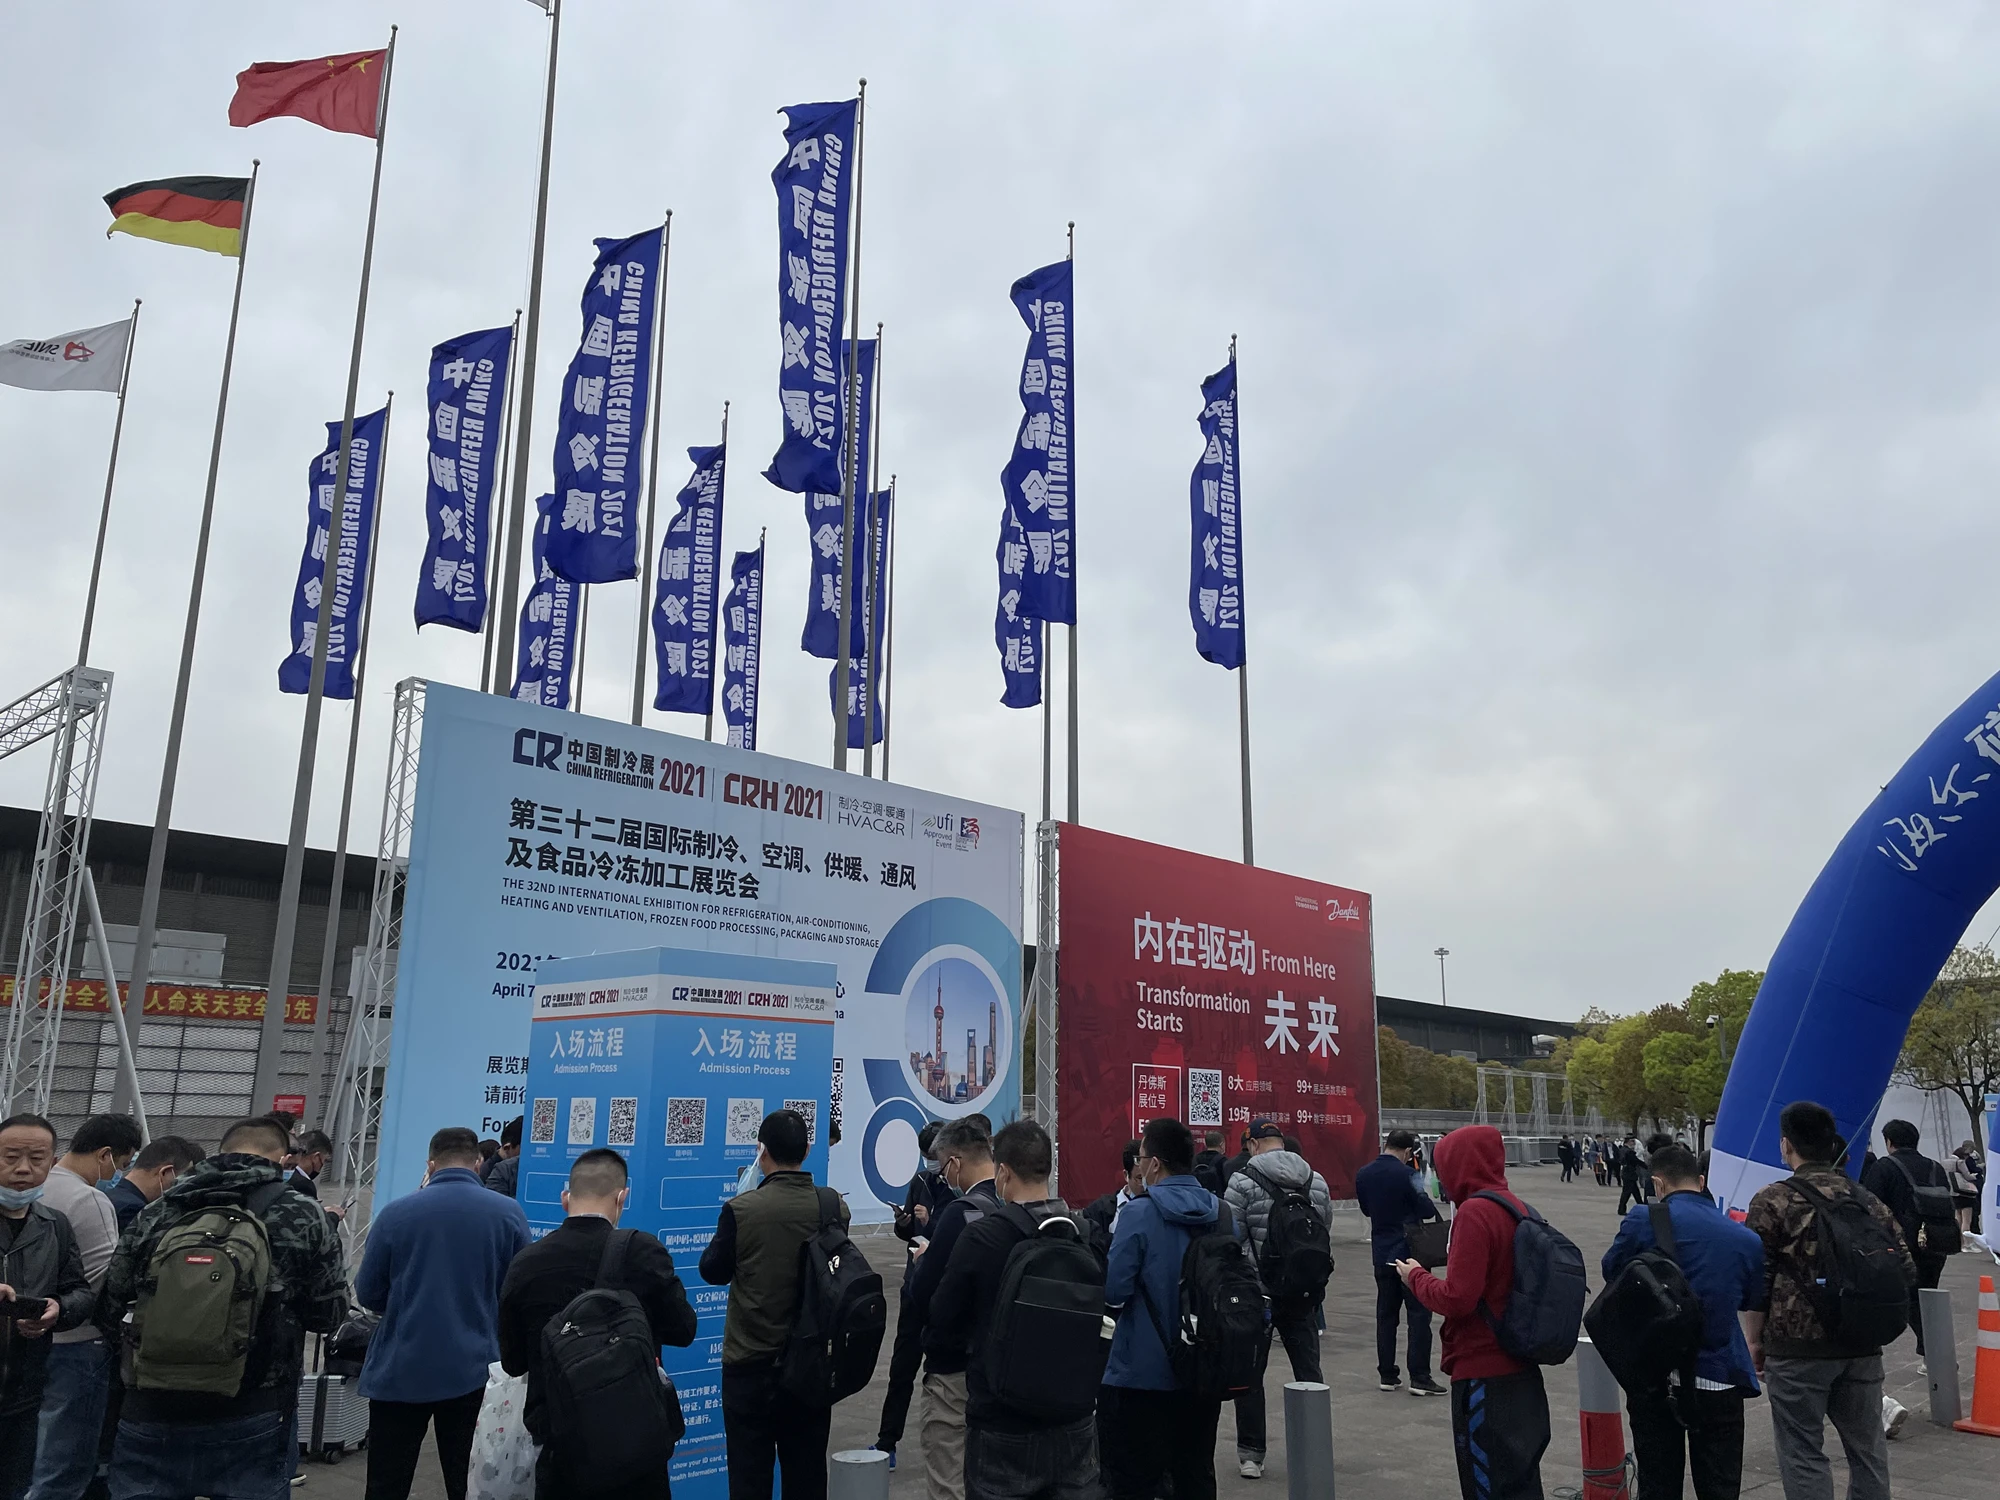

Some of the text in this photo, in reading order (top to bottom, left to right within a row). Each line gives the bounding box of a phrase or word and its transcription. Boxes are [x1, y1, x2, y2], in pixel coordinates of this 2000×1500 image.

[512, 728, 564, 772] CR
[567, 739, 655, 776] 中国制冷展
[566, 762, 654, 790] CHINA REFRIGERATION
[659, 758, 705, 798] 2021
[723, 773, 823, 820] CRH 2021
[838, 811, 905, 836] HVAC&R
[937, 813, 953, 831] ufi
[509, 797, 916, 890] 第三十二届国际制冷、空调、供暖、通风
[924, 829, 952, 841] Approved
[936, 839, 952, 849] Event
[505, 837, 760, 900] 及食品冷冻加工展览会
[502, 877, 871, 934] THE 32ND INTERNATIONAL EXHIBITION FOR REFRIGERATION, AIR-CONDITIONING,
[501, 894, 880, 949] HEATING AND VENTILATION, FROZEN FOOD PROCESSING, PACKAGING AND STORAGE
[1133, 911, 1256, 976] 内在驱动
[1262, 949, 1336, 981] From Here
[492, 982, 536, 998] April 7
[573, 992, 586, 1006] 2021
[589, 989, 619, 1004] CRH 2021
[672, 987, 688, 1001] CR
[724, 990, 742, 1005] 2021
[1136, 981, 1250, 1014] Transformation
[748, 993, 788, 1008] CRH 2021
[794, 1003, 825, 1011] HVAC&R
[1136, 1008, 1183, 1033] Starts
[1264, 990, 1340, 1058] 未来
[550, 1027, 624, 1059] 入场流程
[691, 1028, 797, 1060] 入场流程
[554, 1062, 617, 1074] Admission Process
[699, 1062, 790, 1076] Admission Process
[1138, 1074, 1167, 1092] 丹佛斯
[1228, 1074, 1244, 1091] 8大
[1296, 1079, 1312, 1093] 99+
[1138, 1092, 1167, 1110] 展位号
[1228, 1106, 1250, 1123] 19场
[1296, 1109, 1313, 1123] 99+
[689, 1432, 723, 1443] requirements
[688, 1459, 701, 1468] your
